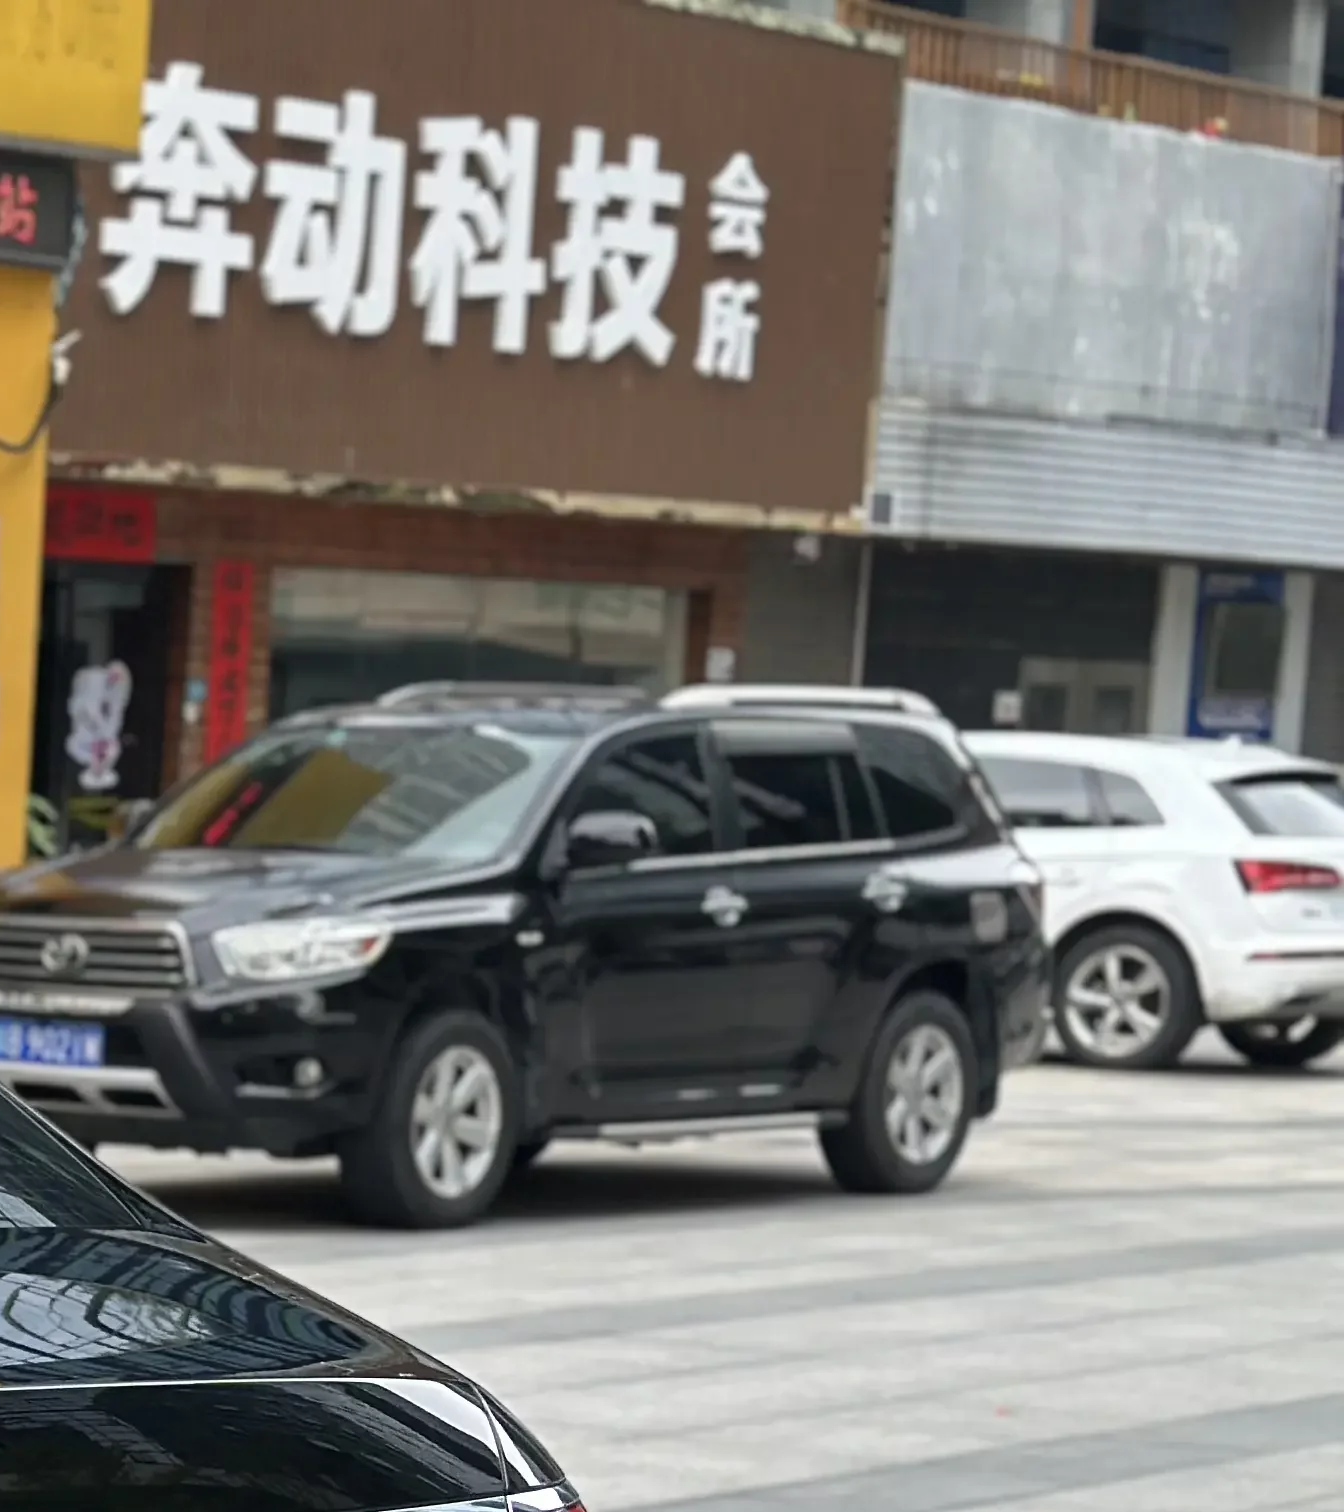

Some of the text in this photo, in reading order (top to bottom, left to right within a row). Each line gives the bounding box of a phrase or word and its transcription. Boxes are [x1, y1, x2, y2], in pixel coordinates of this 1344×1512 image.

[98, 60, 686, 368] 奔动科技
[693, 151, 770, 384] 会所
